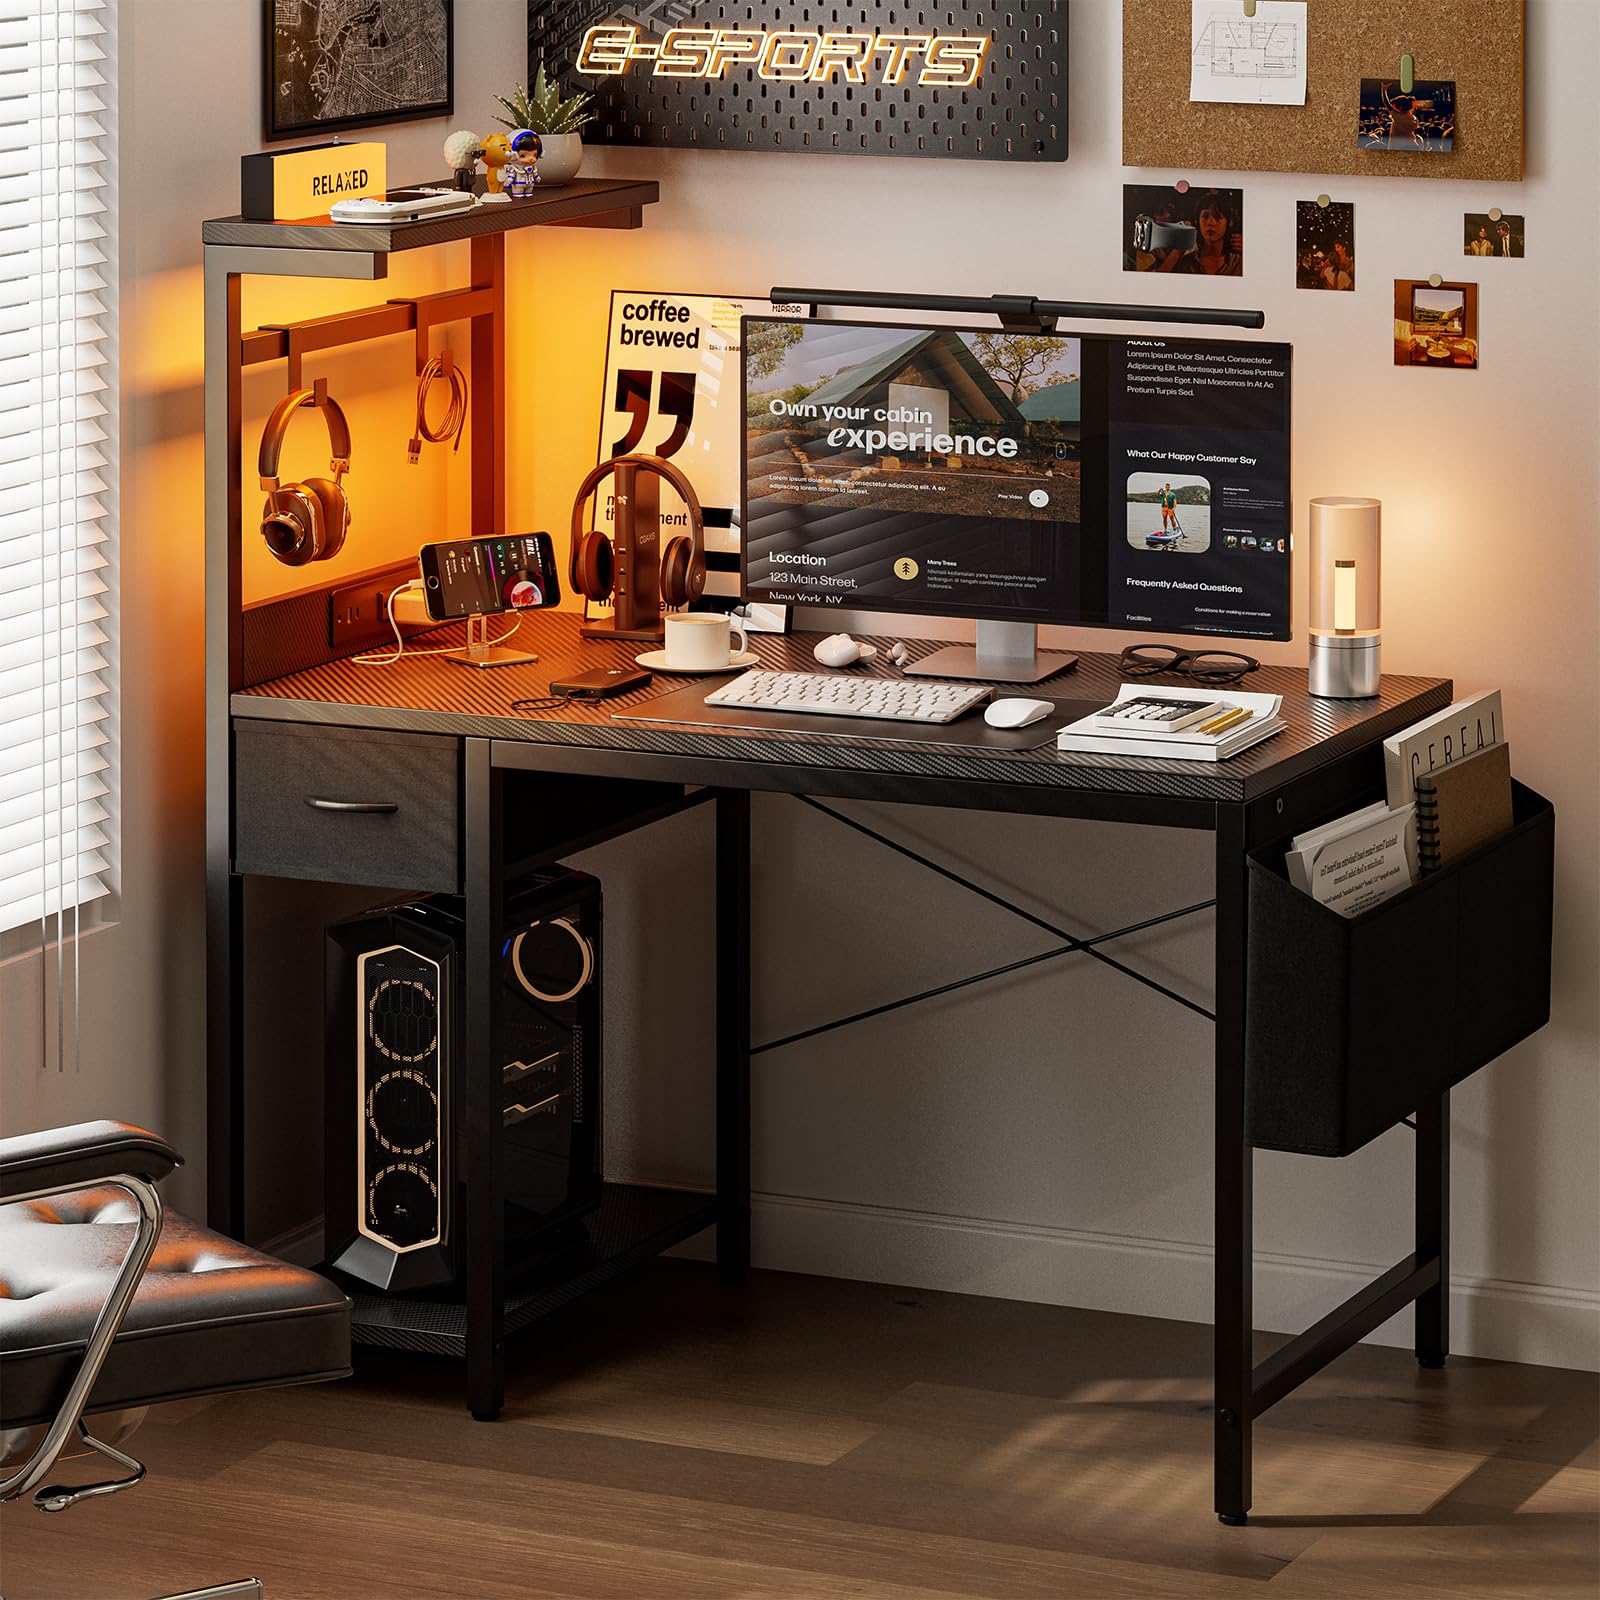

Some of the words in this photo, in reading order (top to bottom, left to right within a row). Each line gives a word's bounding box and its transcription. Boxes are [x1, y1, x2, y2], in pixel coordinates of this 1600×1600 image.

[575, 25, 991, 86] E-SPORTS
[313, 169, 368, 196] RELAXED
[623, 299, 690, 323] coffee
[771, 304, 802, 314] MIRROR
[620, 323, 700, 349] brewed
[1127, 350, 1150, 358] Lorem
[1151, 351, 1173, 359] Ipsum
[1174, 352, 1193, 360] Dolor
[1194, 353, 1204, 361] Sit
[1227, 355, 1273, 364] Consectetur
[1127, 362, 1164, 372] Adipiscing
[1177, 365, 1224, 375] Pellentesque
[1224, 367, 1254, 376] Ultricies
[1254, 369, 1285, 377] Porttitor
[1127, 373, 1174, 383] Suspendisse
[1127, 385, 1155, 394] Pretium
[1155, 387, 1177, 396] Turpis
[769, 399, 818, 418] Own
[822, 404, 870, 422] your
[873, 406, 933, 425] cabin
[827, 426, 1018, 458] experience
[1126, 449, 1150, 458] What
[1150, 451, 1167, 459] Our
[1168, 452, 1195, 462] Happy
[1196, 453, 1239, 464] Customer
[1239, 456, 1257, 466] Say
[769, 483, 800, 491] adipiscing
[851, 480, 887, 488] consectetur
[888, 482, 919, 491] adipiscing
[769, 551, 827, 566] Location
[769, 571, 788, 583] 123
[790, 573, 818, 585] Main
[819, 575, 858, 588] Street,
[1126, 577, 1171, 590] Frequently
[1172, 581, 1198, 591] Asked
[1199, 582, 1243, 594] Questions
[1126, 614, 1152, 622] Facilities
